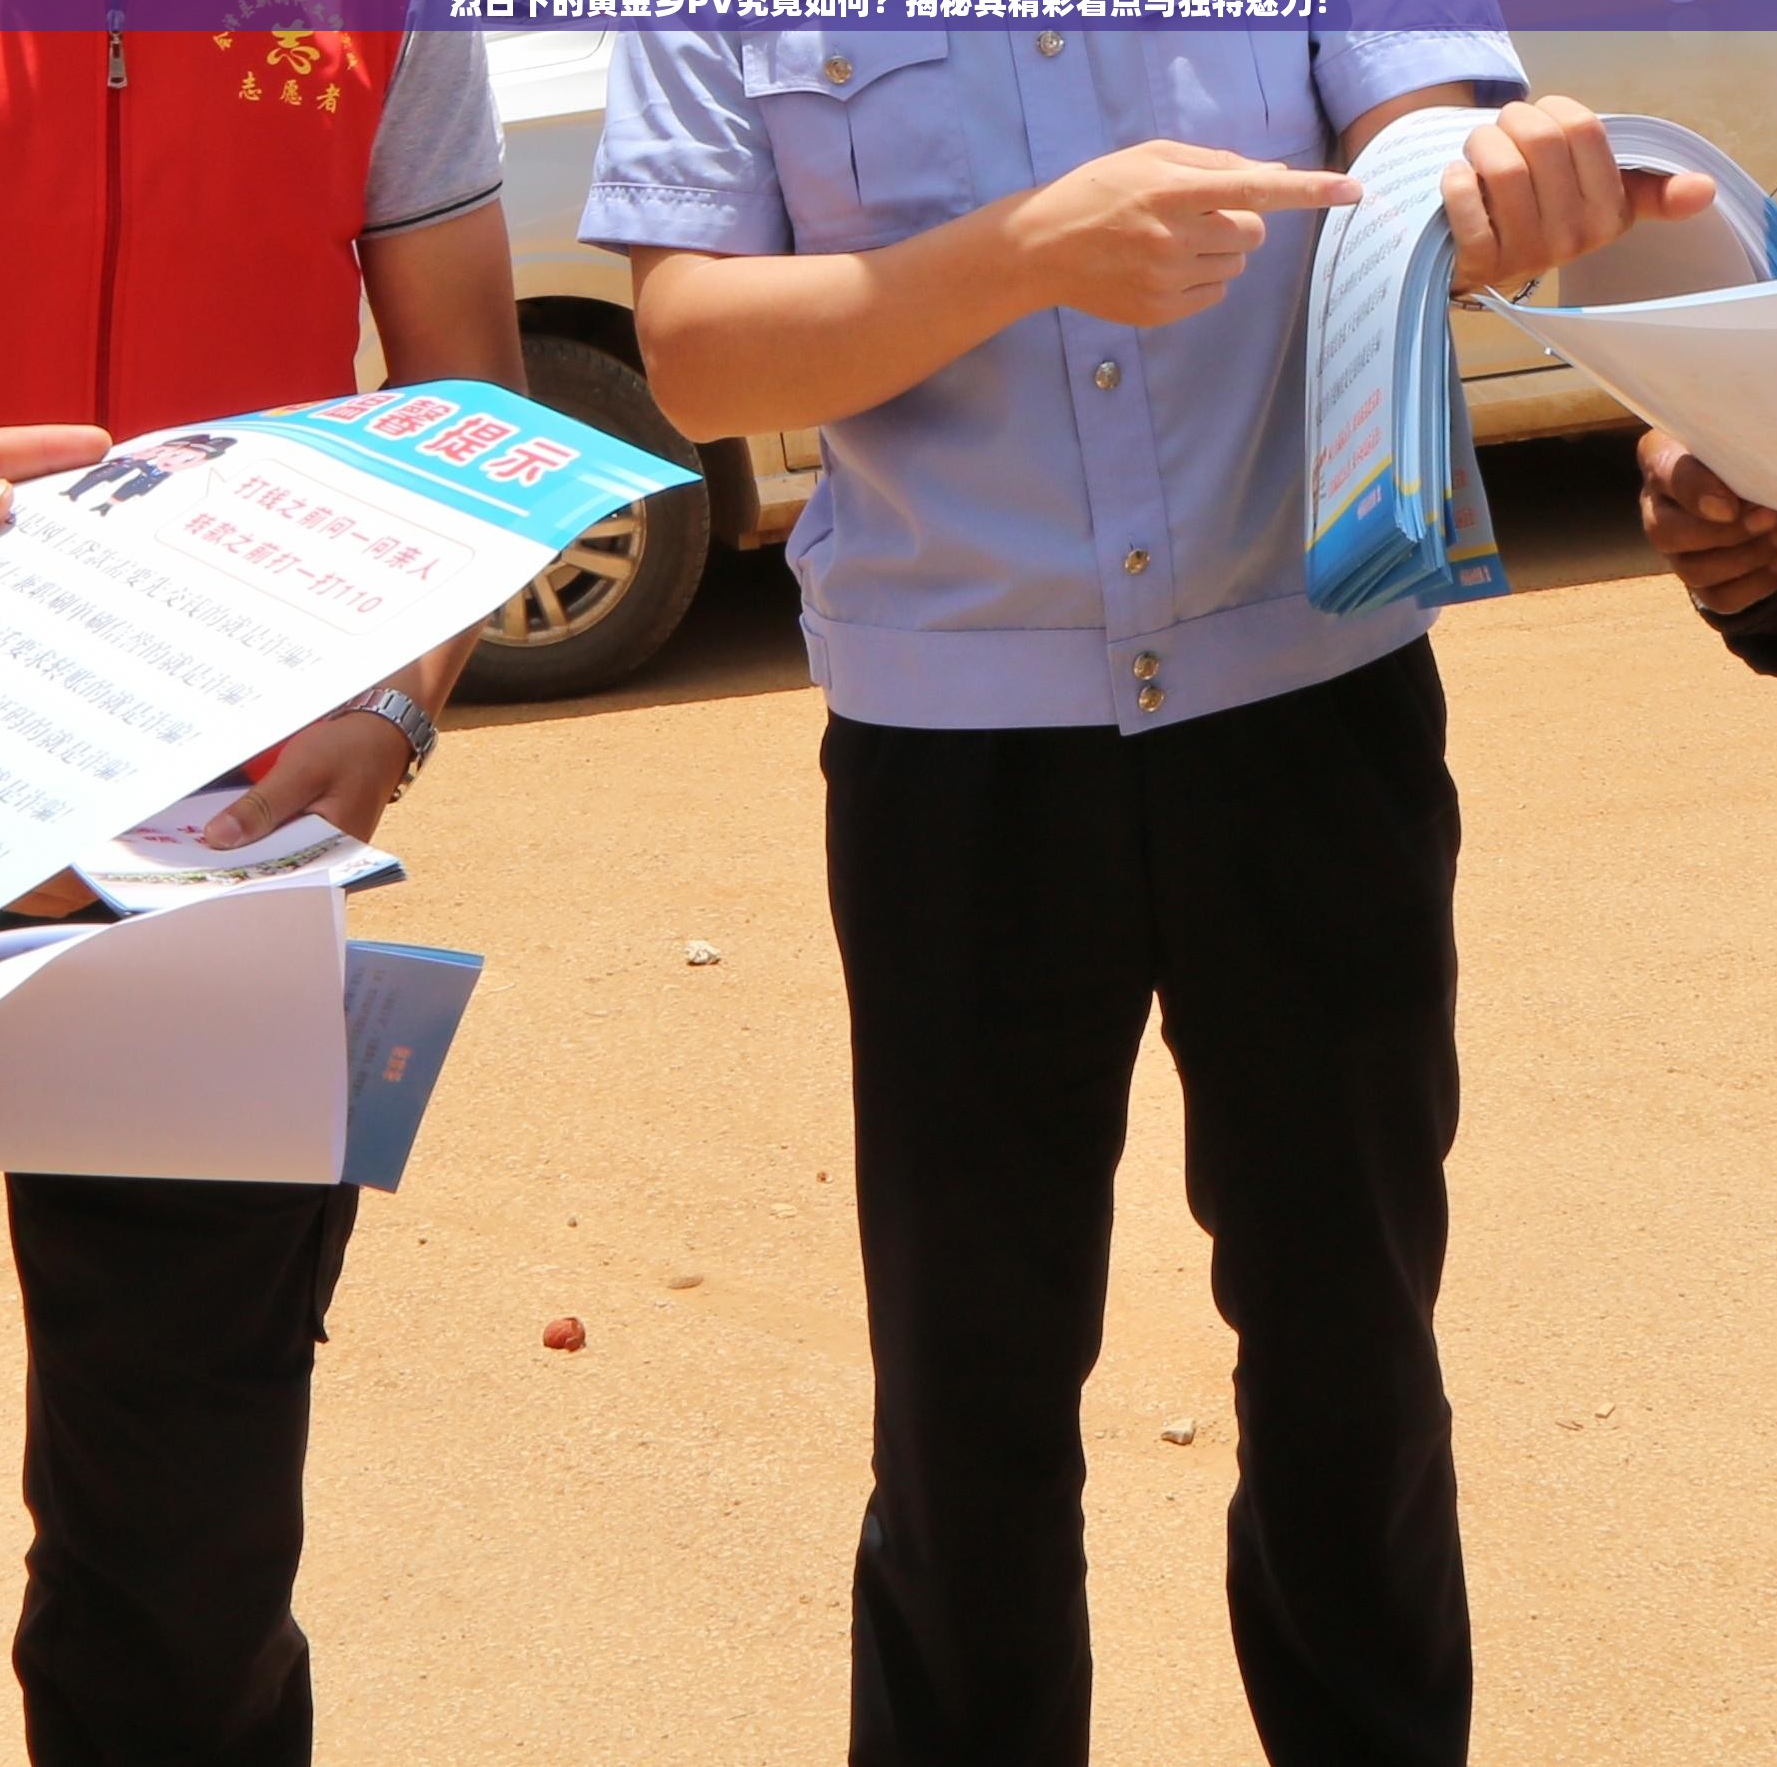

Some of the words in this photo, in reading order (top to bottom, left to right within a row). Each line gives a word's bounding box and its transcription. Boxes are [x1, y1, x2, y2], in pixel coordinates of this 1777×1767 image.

[238, 71, 341, 113] 志愿者
[183, 510, 384, 614] 转款之前打一打110
[234, 474, 441, 582] 打钱之前问一问亲人
